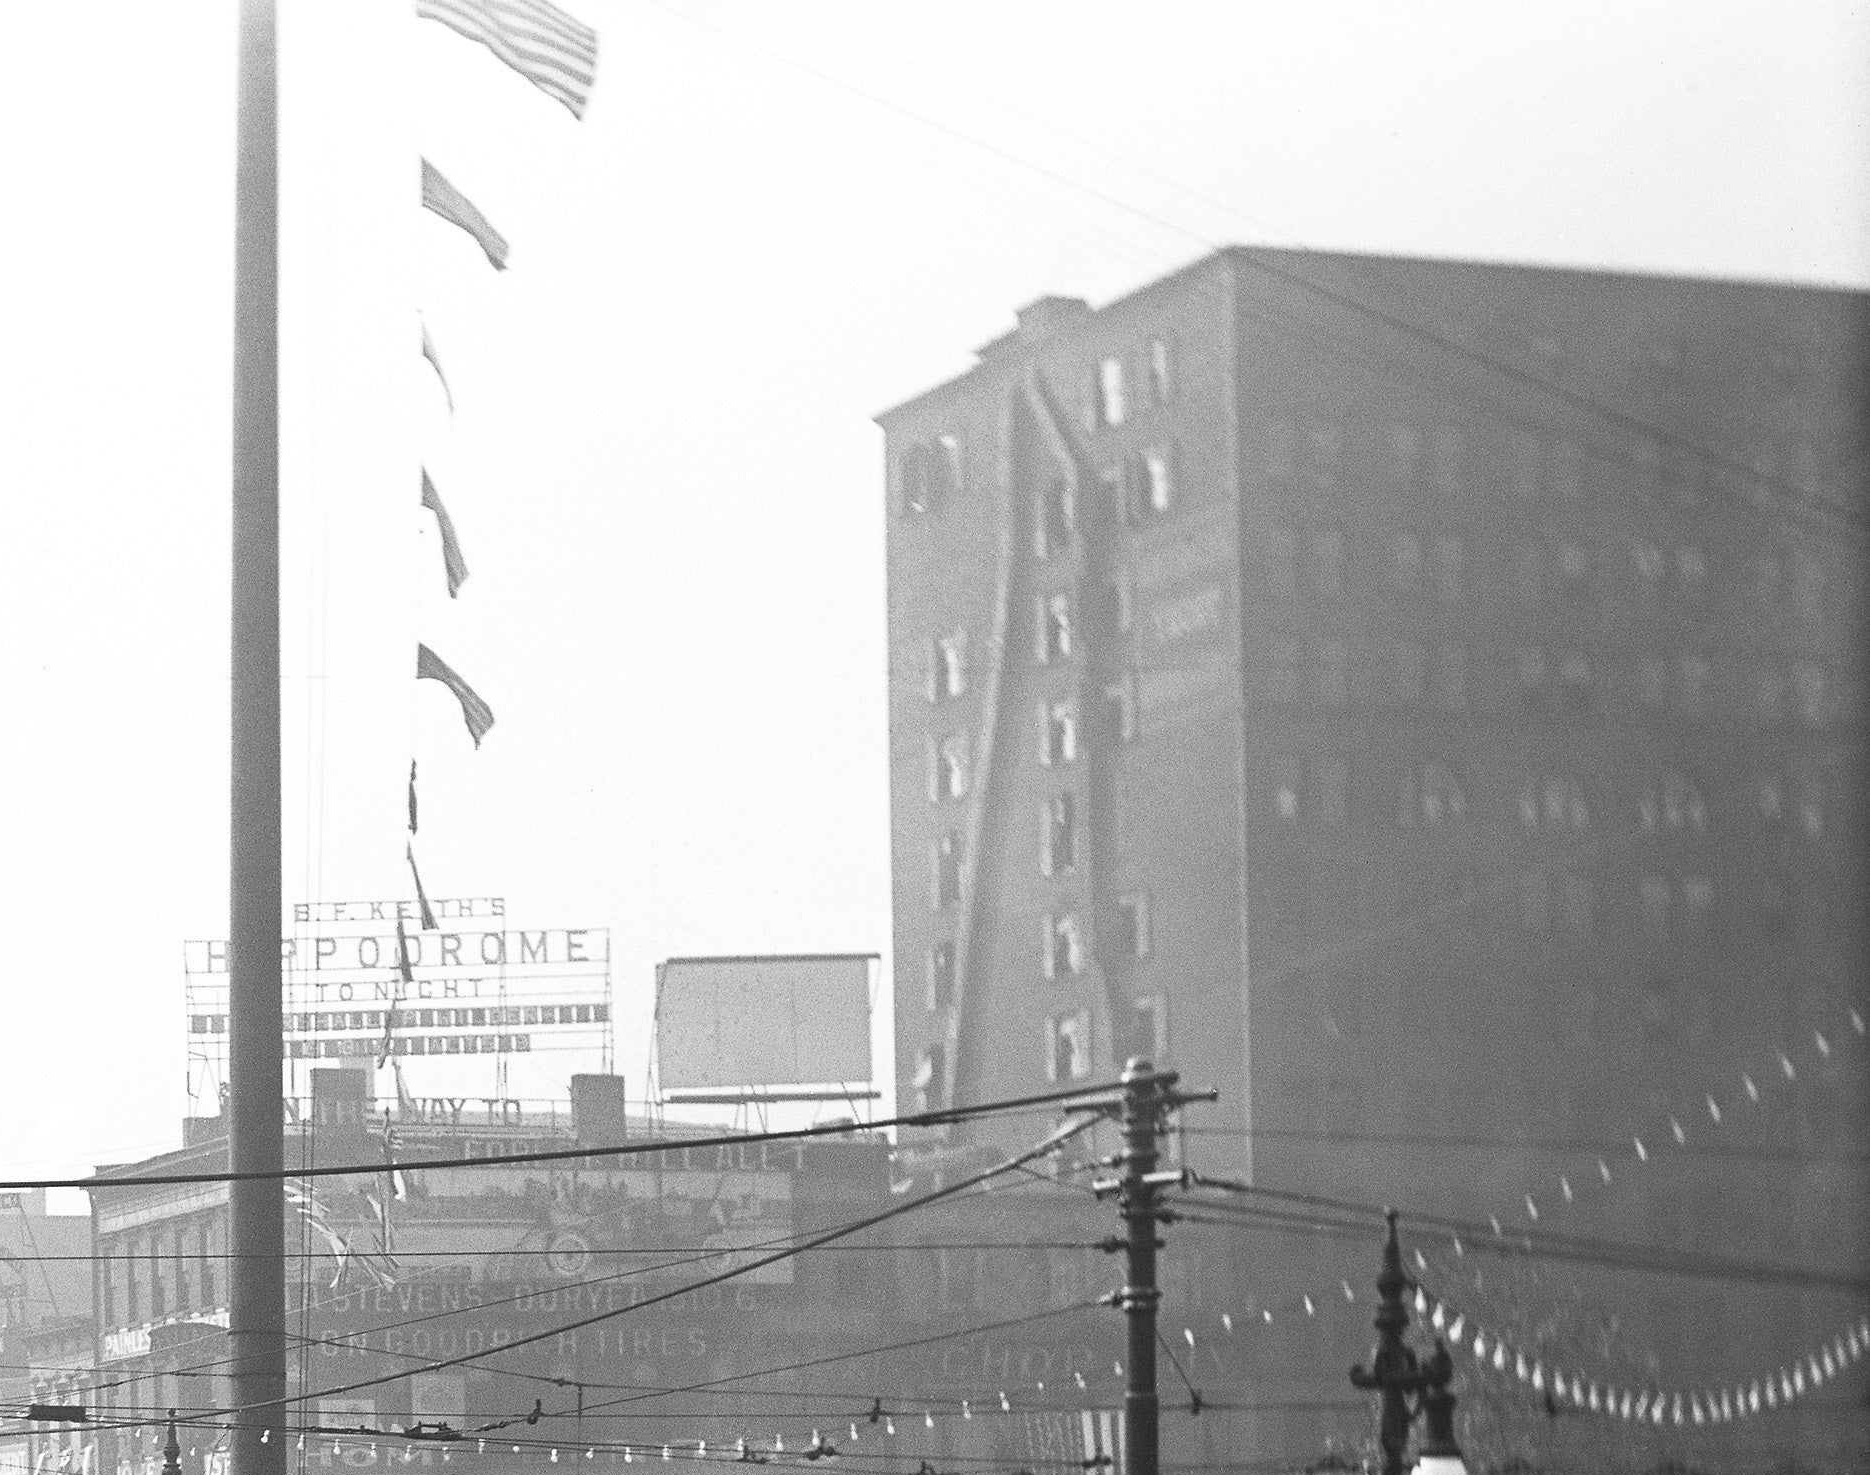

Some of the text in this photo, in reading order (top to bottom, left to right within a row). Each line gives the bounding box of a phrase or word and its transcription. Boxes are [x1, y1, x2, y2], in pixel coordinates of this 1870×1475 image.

[371, 898, 506, 919] KETH'S
[207, 930, 590, 974] HPPODROME
[597, 1327, 708, 1357] TIRES
